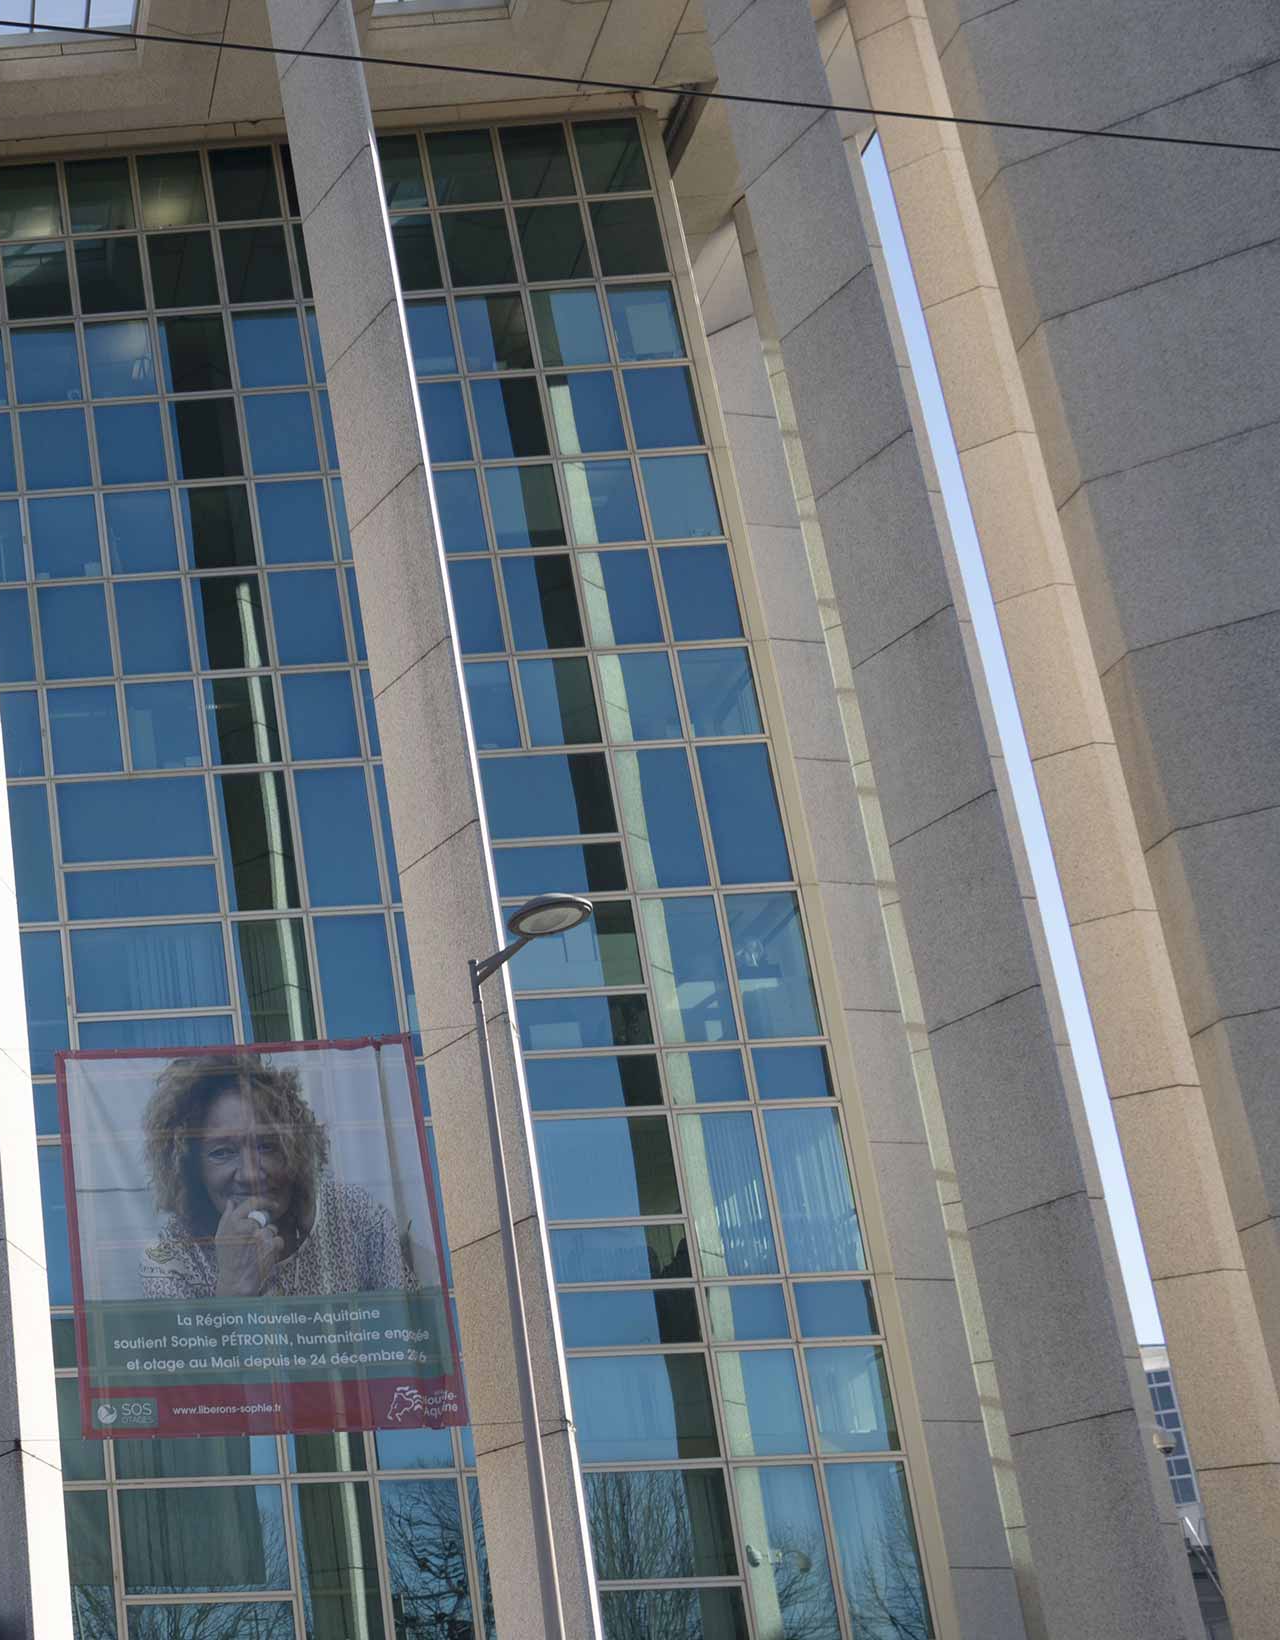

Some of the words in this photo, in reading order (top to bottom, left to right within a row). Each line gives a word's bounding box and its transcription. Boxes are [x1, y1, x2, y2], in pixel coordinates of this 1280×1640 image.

[177, 1314, 192, 1327] La
[196, 1313, 244, 1328] Région
[248, 1308, 381, 1326] Nouvelle-Aquitaine
[113, 1335, 167, 1350] soutient
[171, 1335, 218, 1350] Sophie
[221, 1331, 293, 1347] PÉTRONIN,
[297, 1328, 381, 1346] humanitaire
[126, 1358, 140, 1370] et
[144, 1357, 185, 1373] otage
[190, 1358, 207, 1369] au
[211, 1355, 240, 1369] Mali
[244, 1354, 290, 1370] depuis
[294, 1354, 306, 1366] le
[310, 1354, 327, 1366] 24
[330, 1349, 404, 1365] décembre
[121, 1403, 152, 1416] SOS
[172, 1402, 282, 1416] www.liberons-sophie.fr
